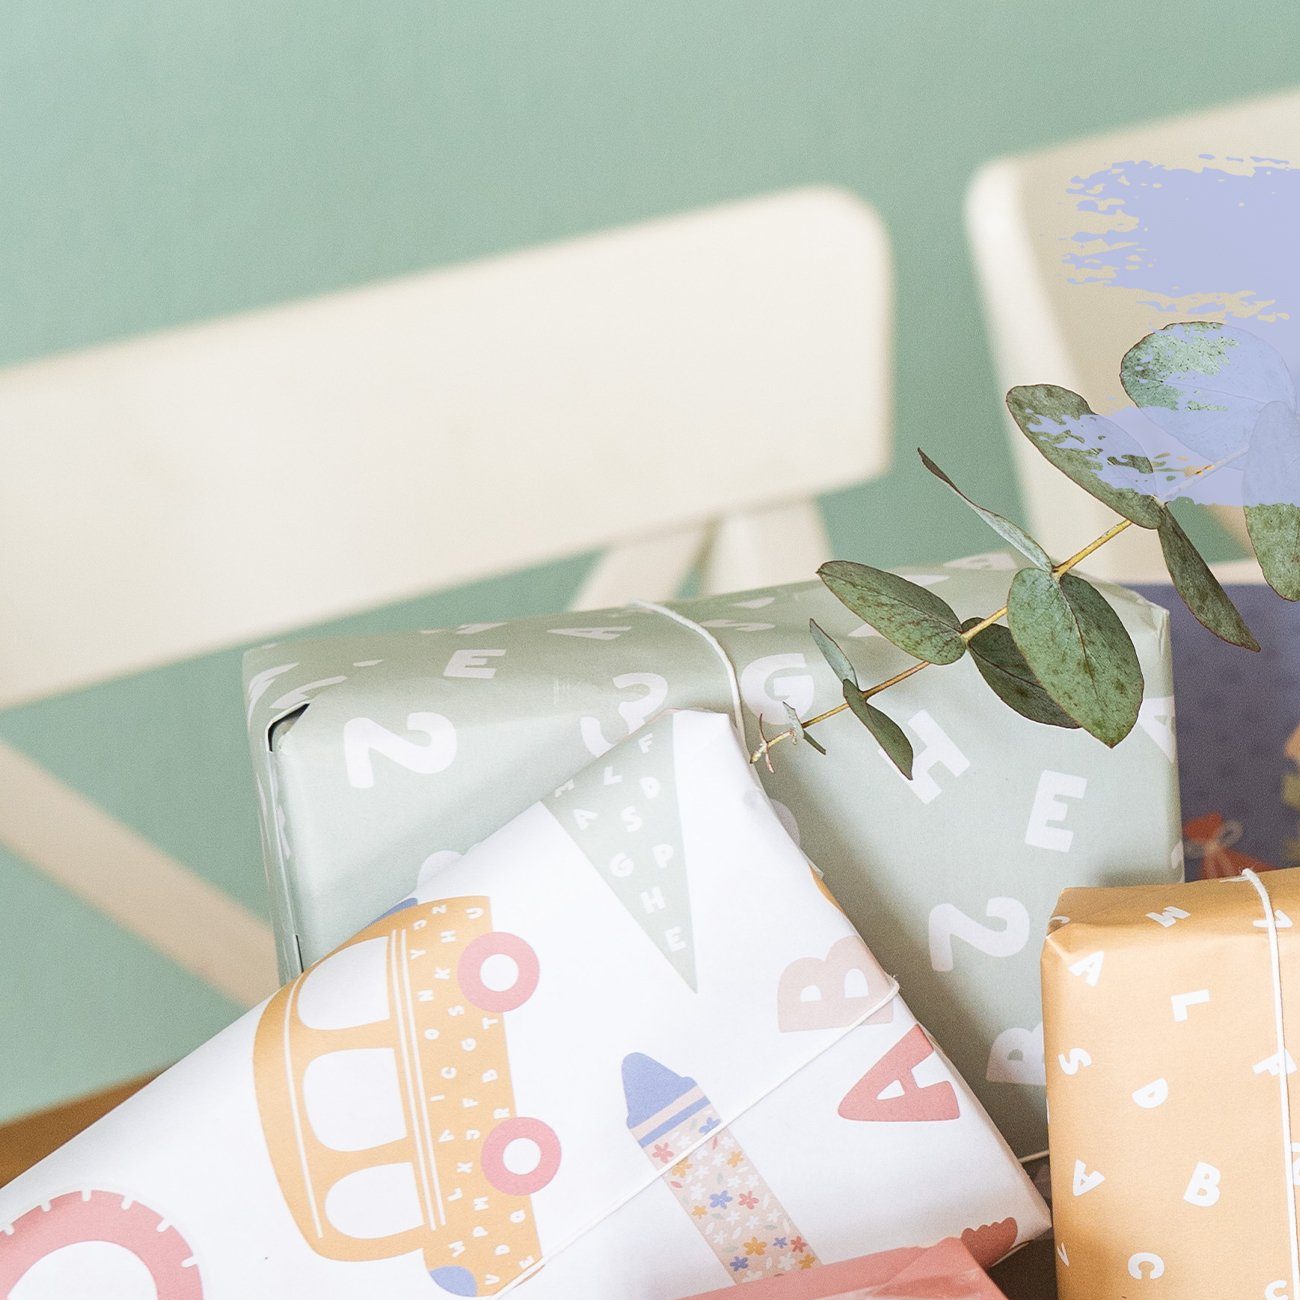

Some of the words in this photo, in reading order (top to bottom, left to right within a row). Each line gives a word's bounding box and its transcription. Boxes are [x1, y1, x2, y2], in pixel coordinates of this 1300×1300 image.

[443, 649, 506, 679] E
[740, 653, 815, 725] G
[343, 711, 458, 789] 2
[1025, 769, 1088, 853] E
[928, 896, 1030, 973] 2
[776, 934, 895, 1035] B
[1069, 950, 1105, 987] A
[1170, 989, 1210, 1022] L
[837, 1023, 960, 1123] A
[1058, 1047, 1092, 1075] S
[1131, 1077, 1169, 1109] D
[1072, 1159, 1105, 1196] A
[1183, 1161, 1221, 1207] B
[1128, 1252, 1165, 1279] C
